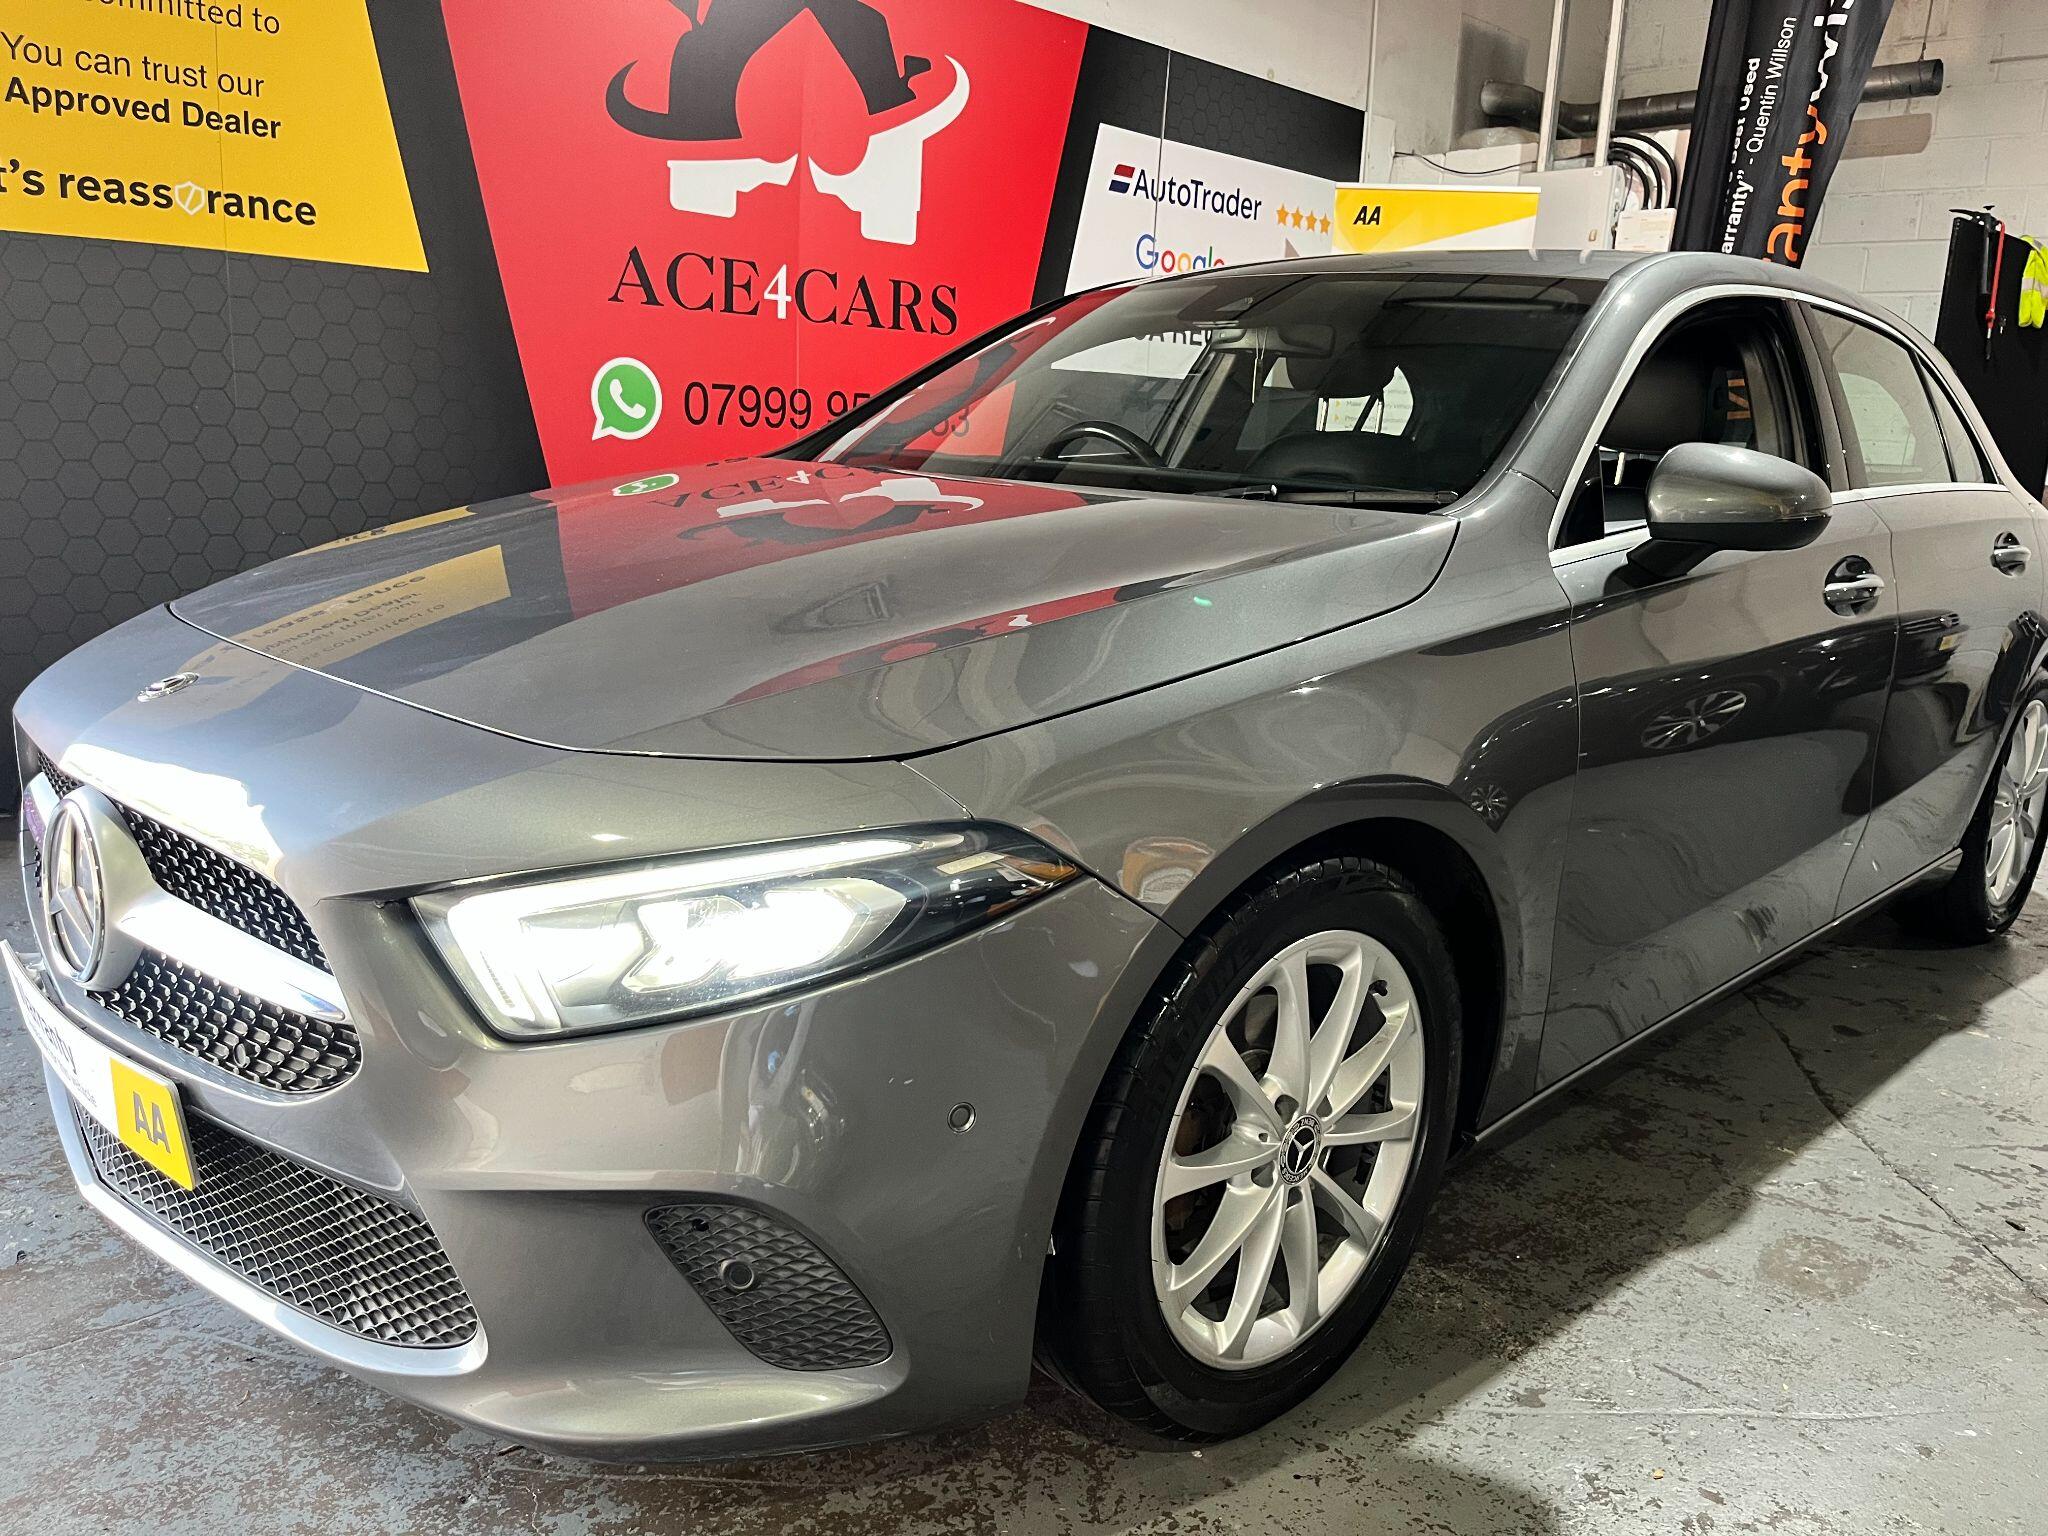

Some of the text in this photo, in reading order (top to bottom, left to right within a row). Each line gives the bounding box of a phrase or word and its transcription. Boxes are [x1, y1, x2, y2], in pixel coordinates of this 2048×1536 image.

[252, 8, 280, 34] to
[1, 31, 264, 97] You can trust our
[1746, 84, 1779, 153] Quentin
[1765, 16, 1797, 81] Willson
[5, 76, 281, 139] Approved Dealer
[1133, 168, 1262, 220] AutoTrader
[1353, 205, 1382, 226] AA
[608, 245, 958, 336] ACE4CARS
[684, 380, 812, 430] 07999
[132, 1091, 171, 1154] AA
